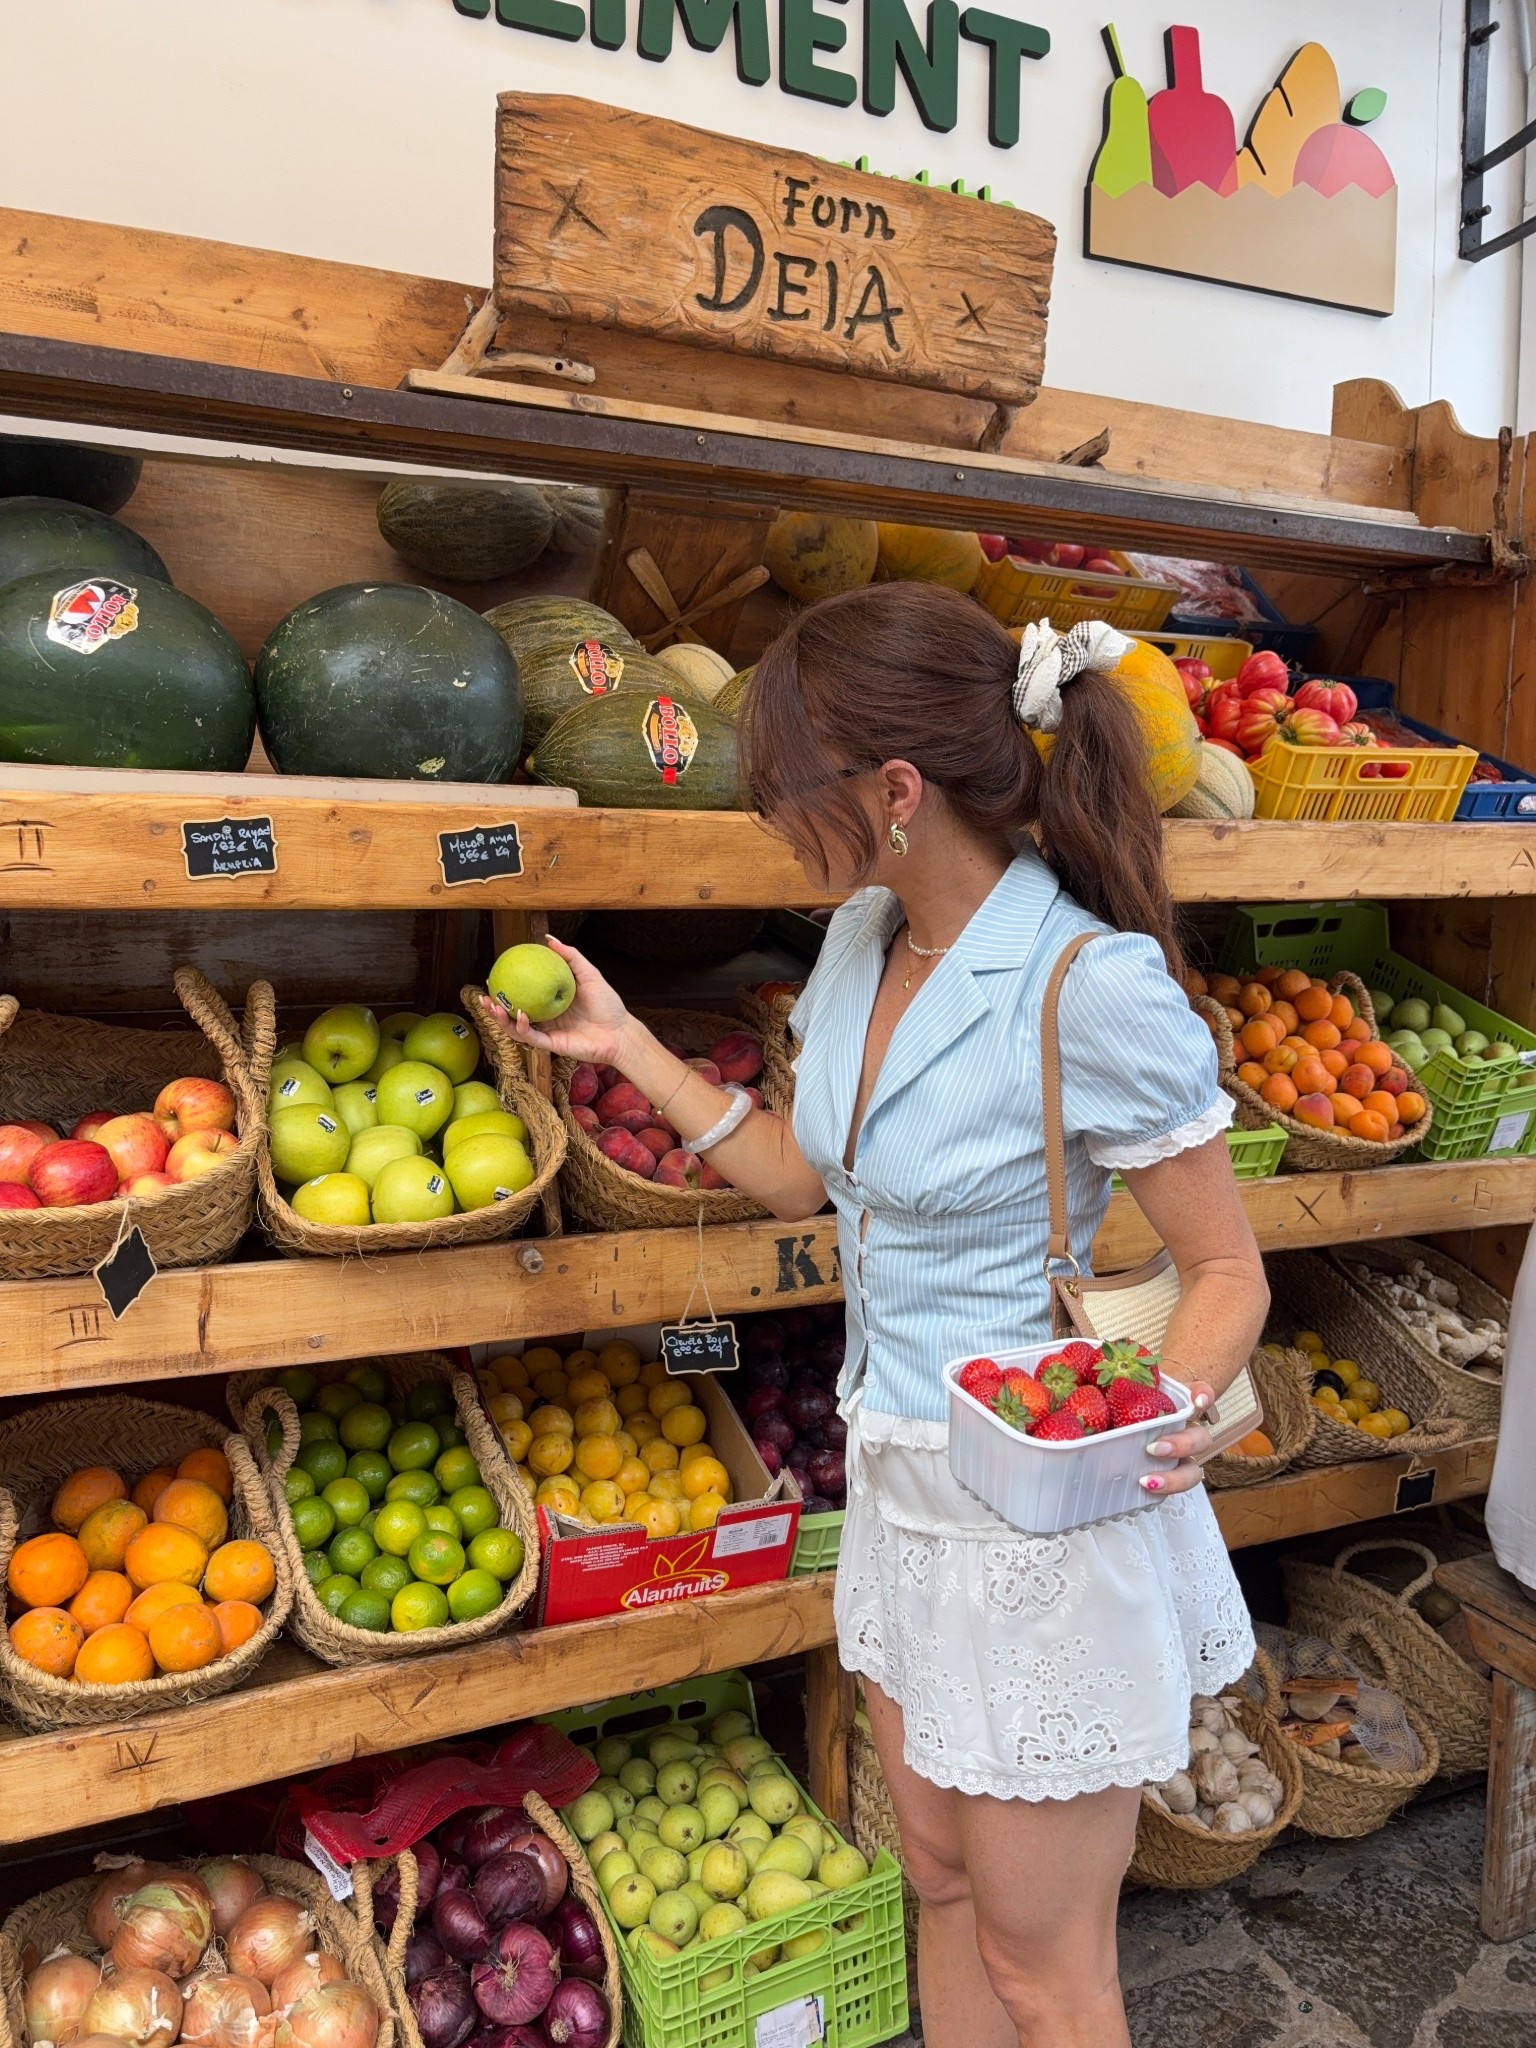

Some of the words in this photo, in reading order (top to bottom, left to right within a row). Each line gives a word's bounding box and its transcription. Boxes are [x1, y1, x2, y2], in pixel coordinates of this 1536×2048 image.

[782, 176, 896, 240] Forn
[693, 205, 904, 352] DEIA
[85, 593, 128, 640] BOLLO
[586, 642, 606, 685] BOLLO
[660, 705, 679, 765] BOLLO
